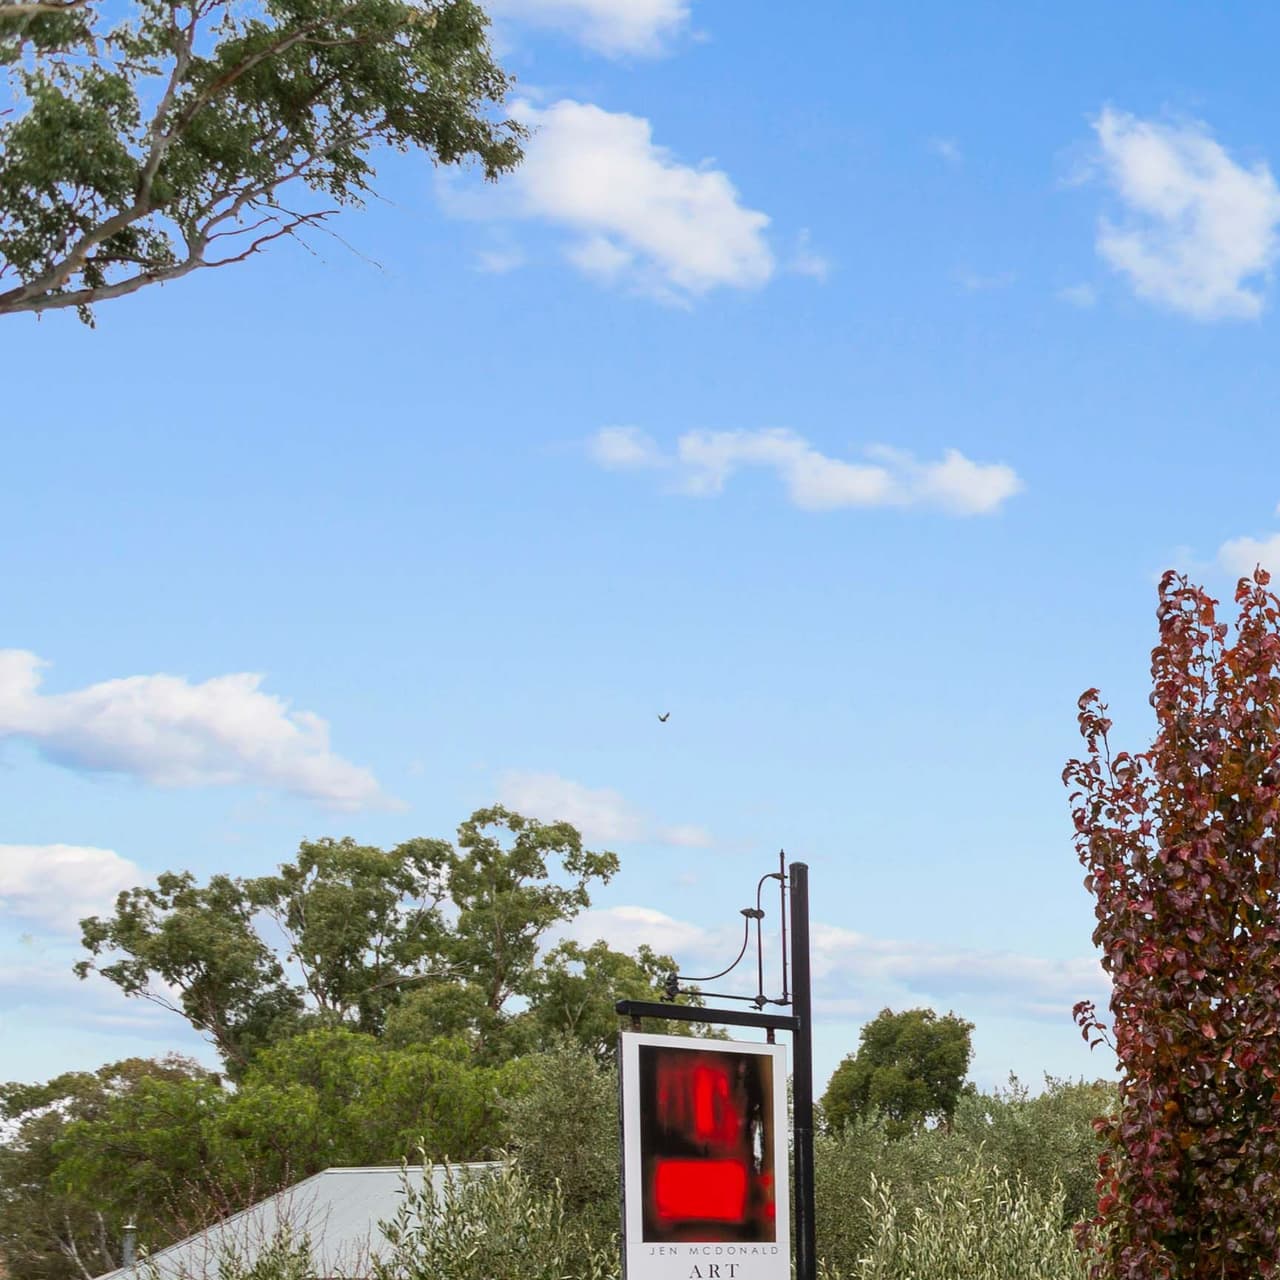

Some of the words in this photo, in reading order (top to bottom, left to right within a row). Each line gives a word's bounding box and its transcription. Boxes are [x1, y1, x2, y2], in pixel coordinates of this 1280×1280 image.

[650, 1247, 678, 1256] JEN
[689, 1246, 779, 1256] MCDONALD
[689, 1263, 739, 1279] ART
